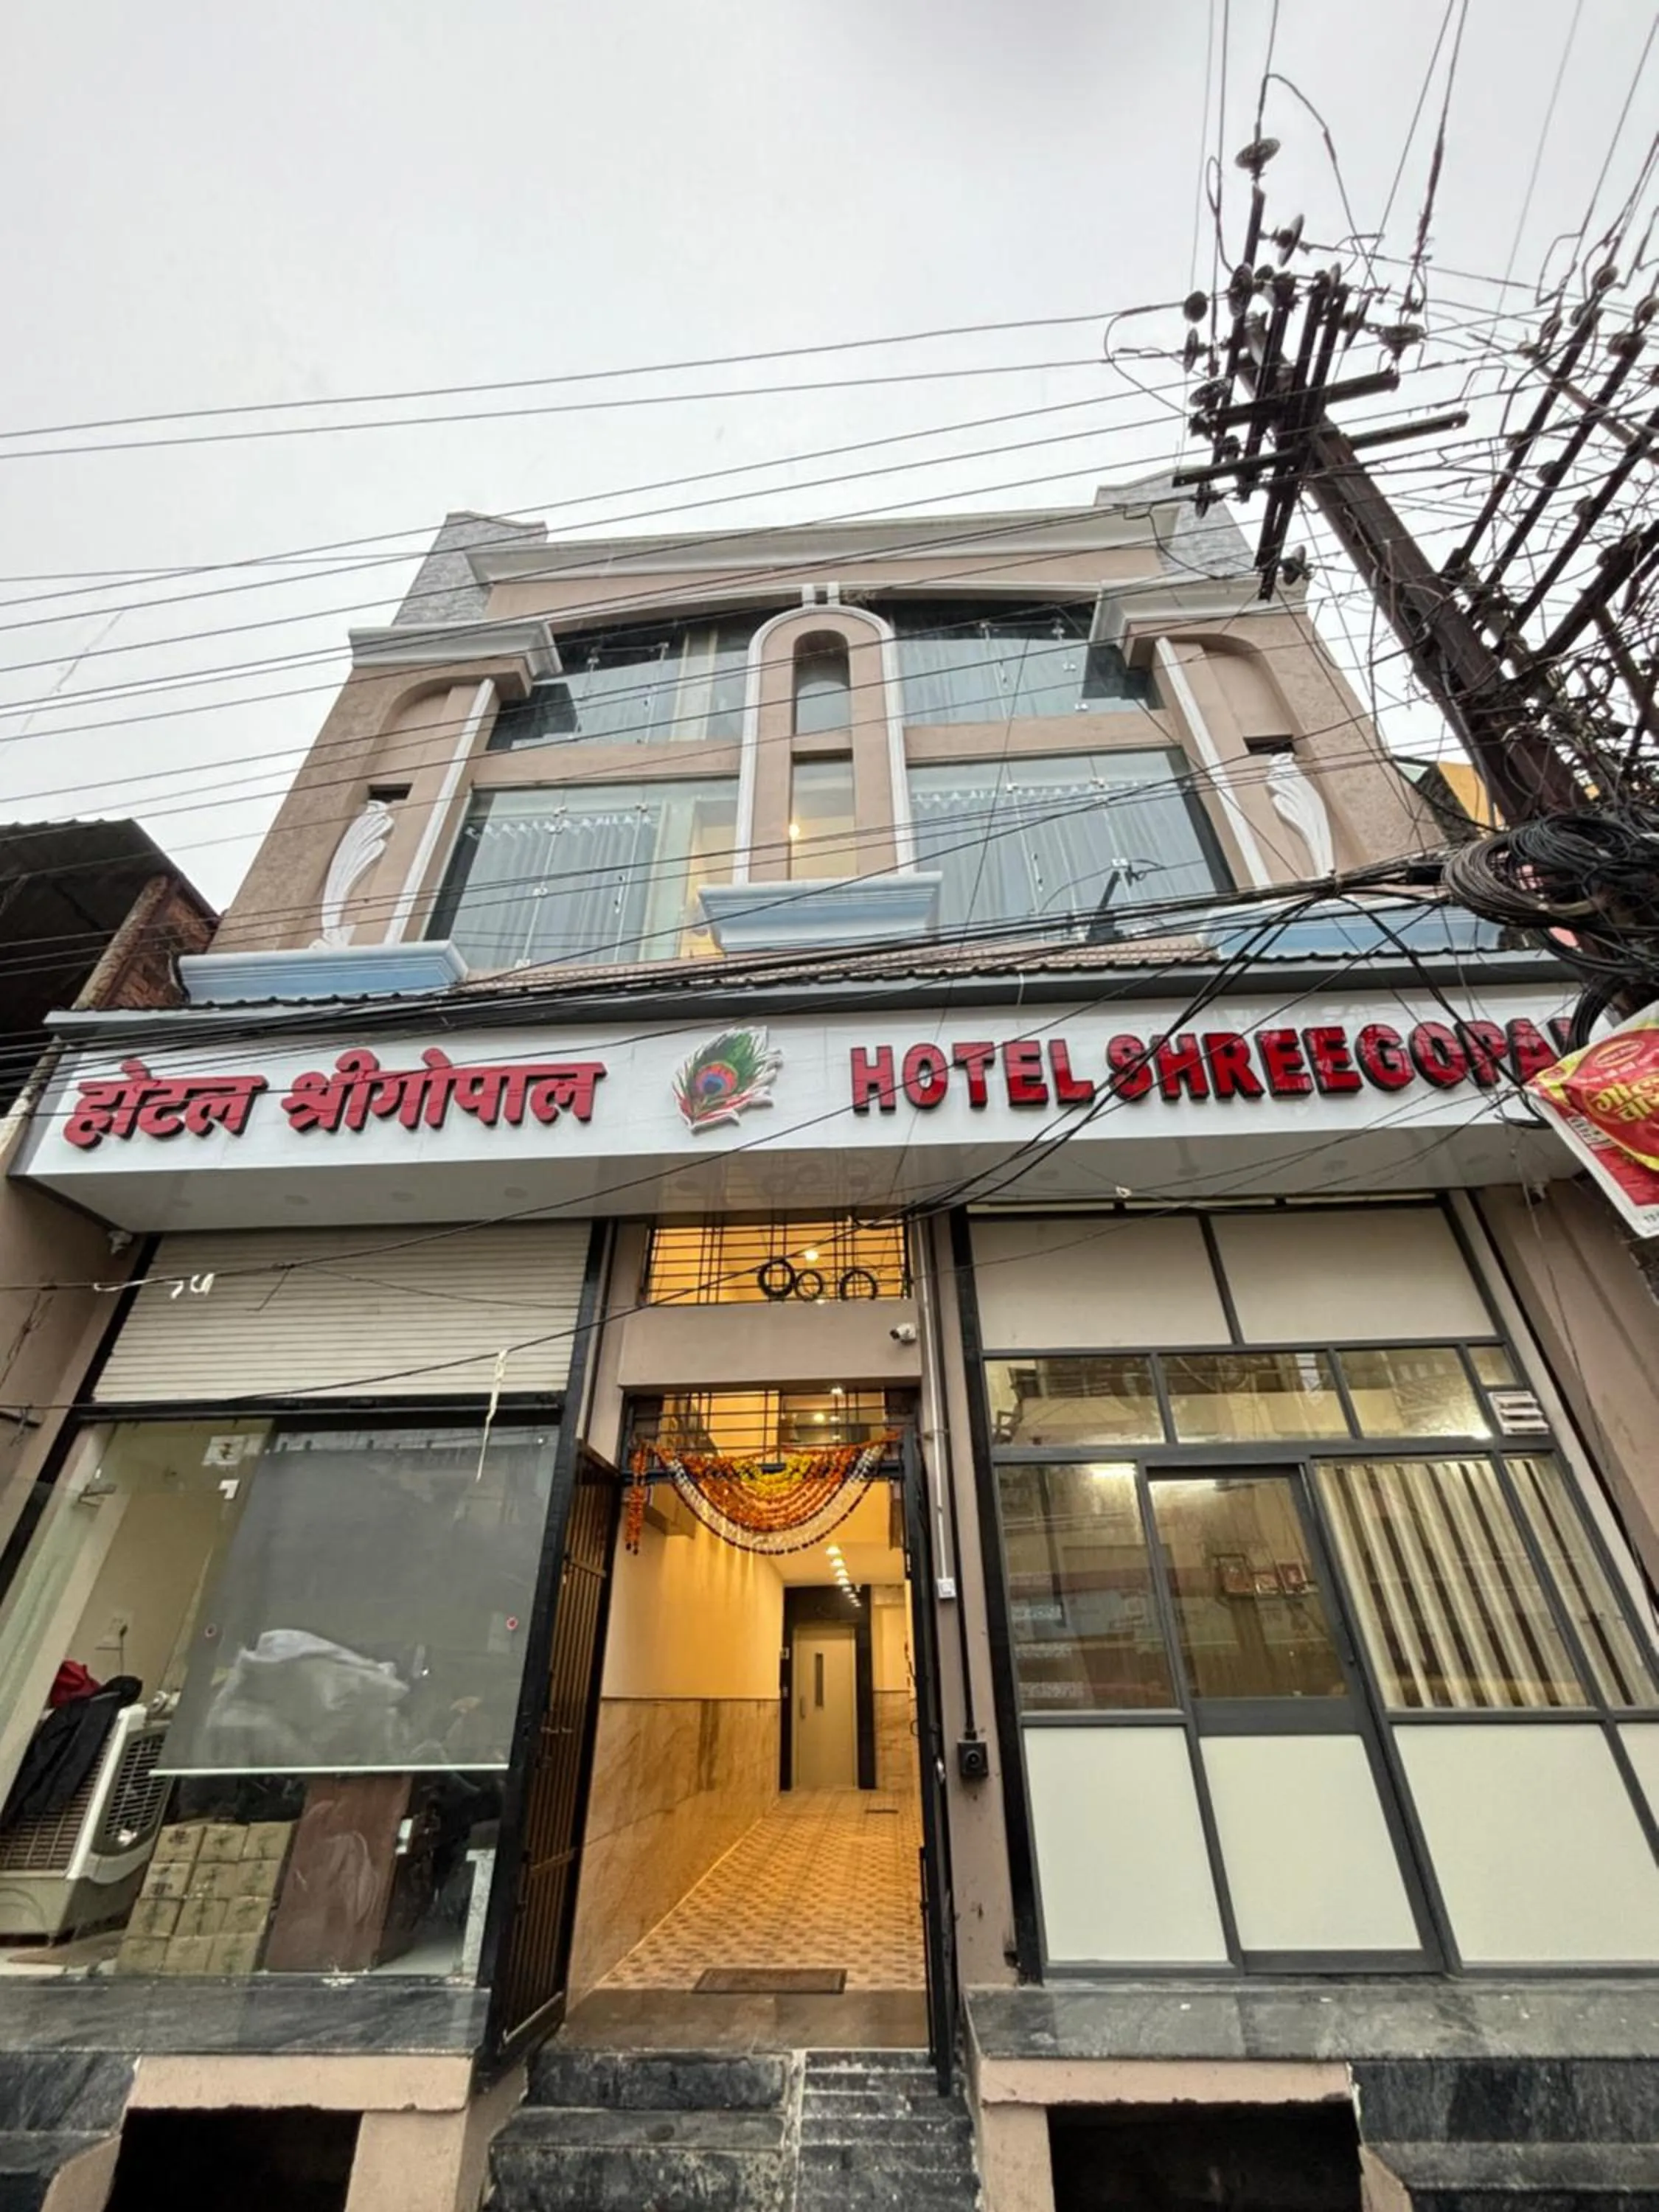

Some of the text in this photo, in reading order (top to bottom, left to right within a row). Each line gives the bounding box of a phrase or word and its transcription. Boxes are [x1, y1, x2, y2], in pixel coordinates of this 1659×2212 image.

[63, 1047, 607, 1149] होटल श्रीगोपाल
[850, 1039, 1096, 1113] HOTEL
